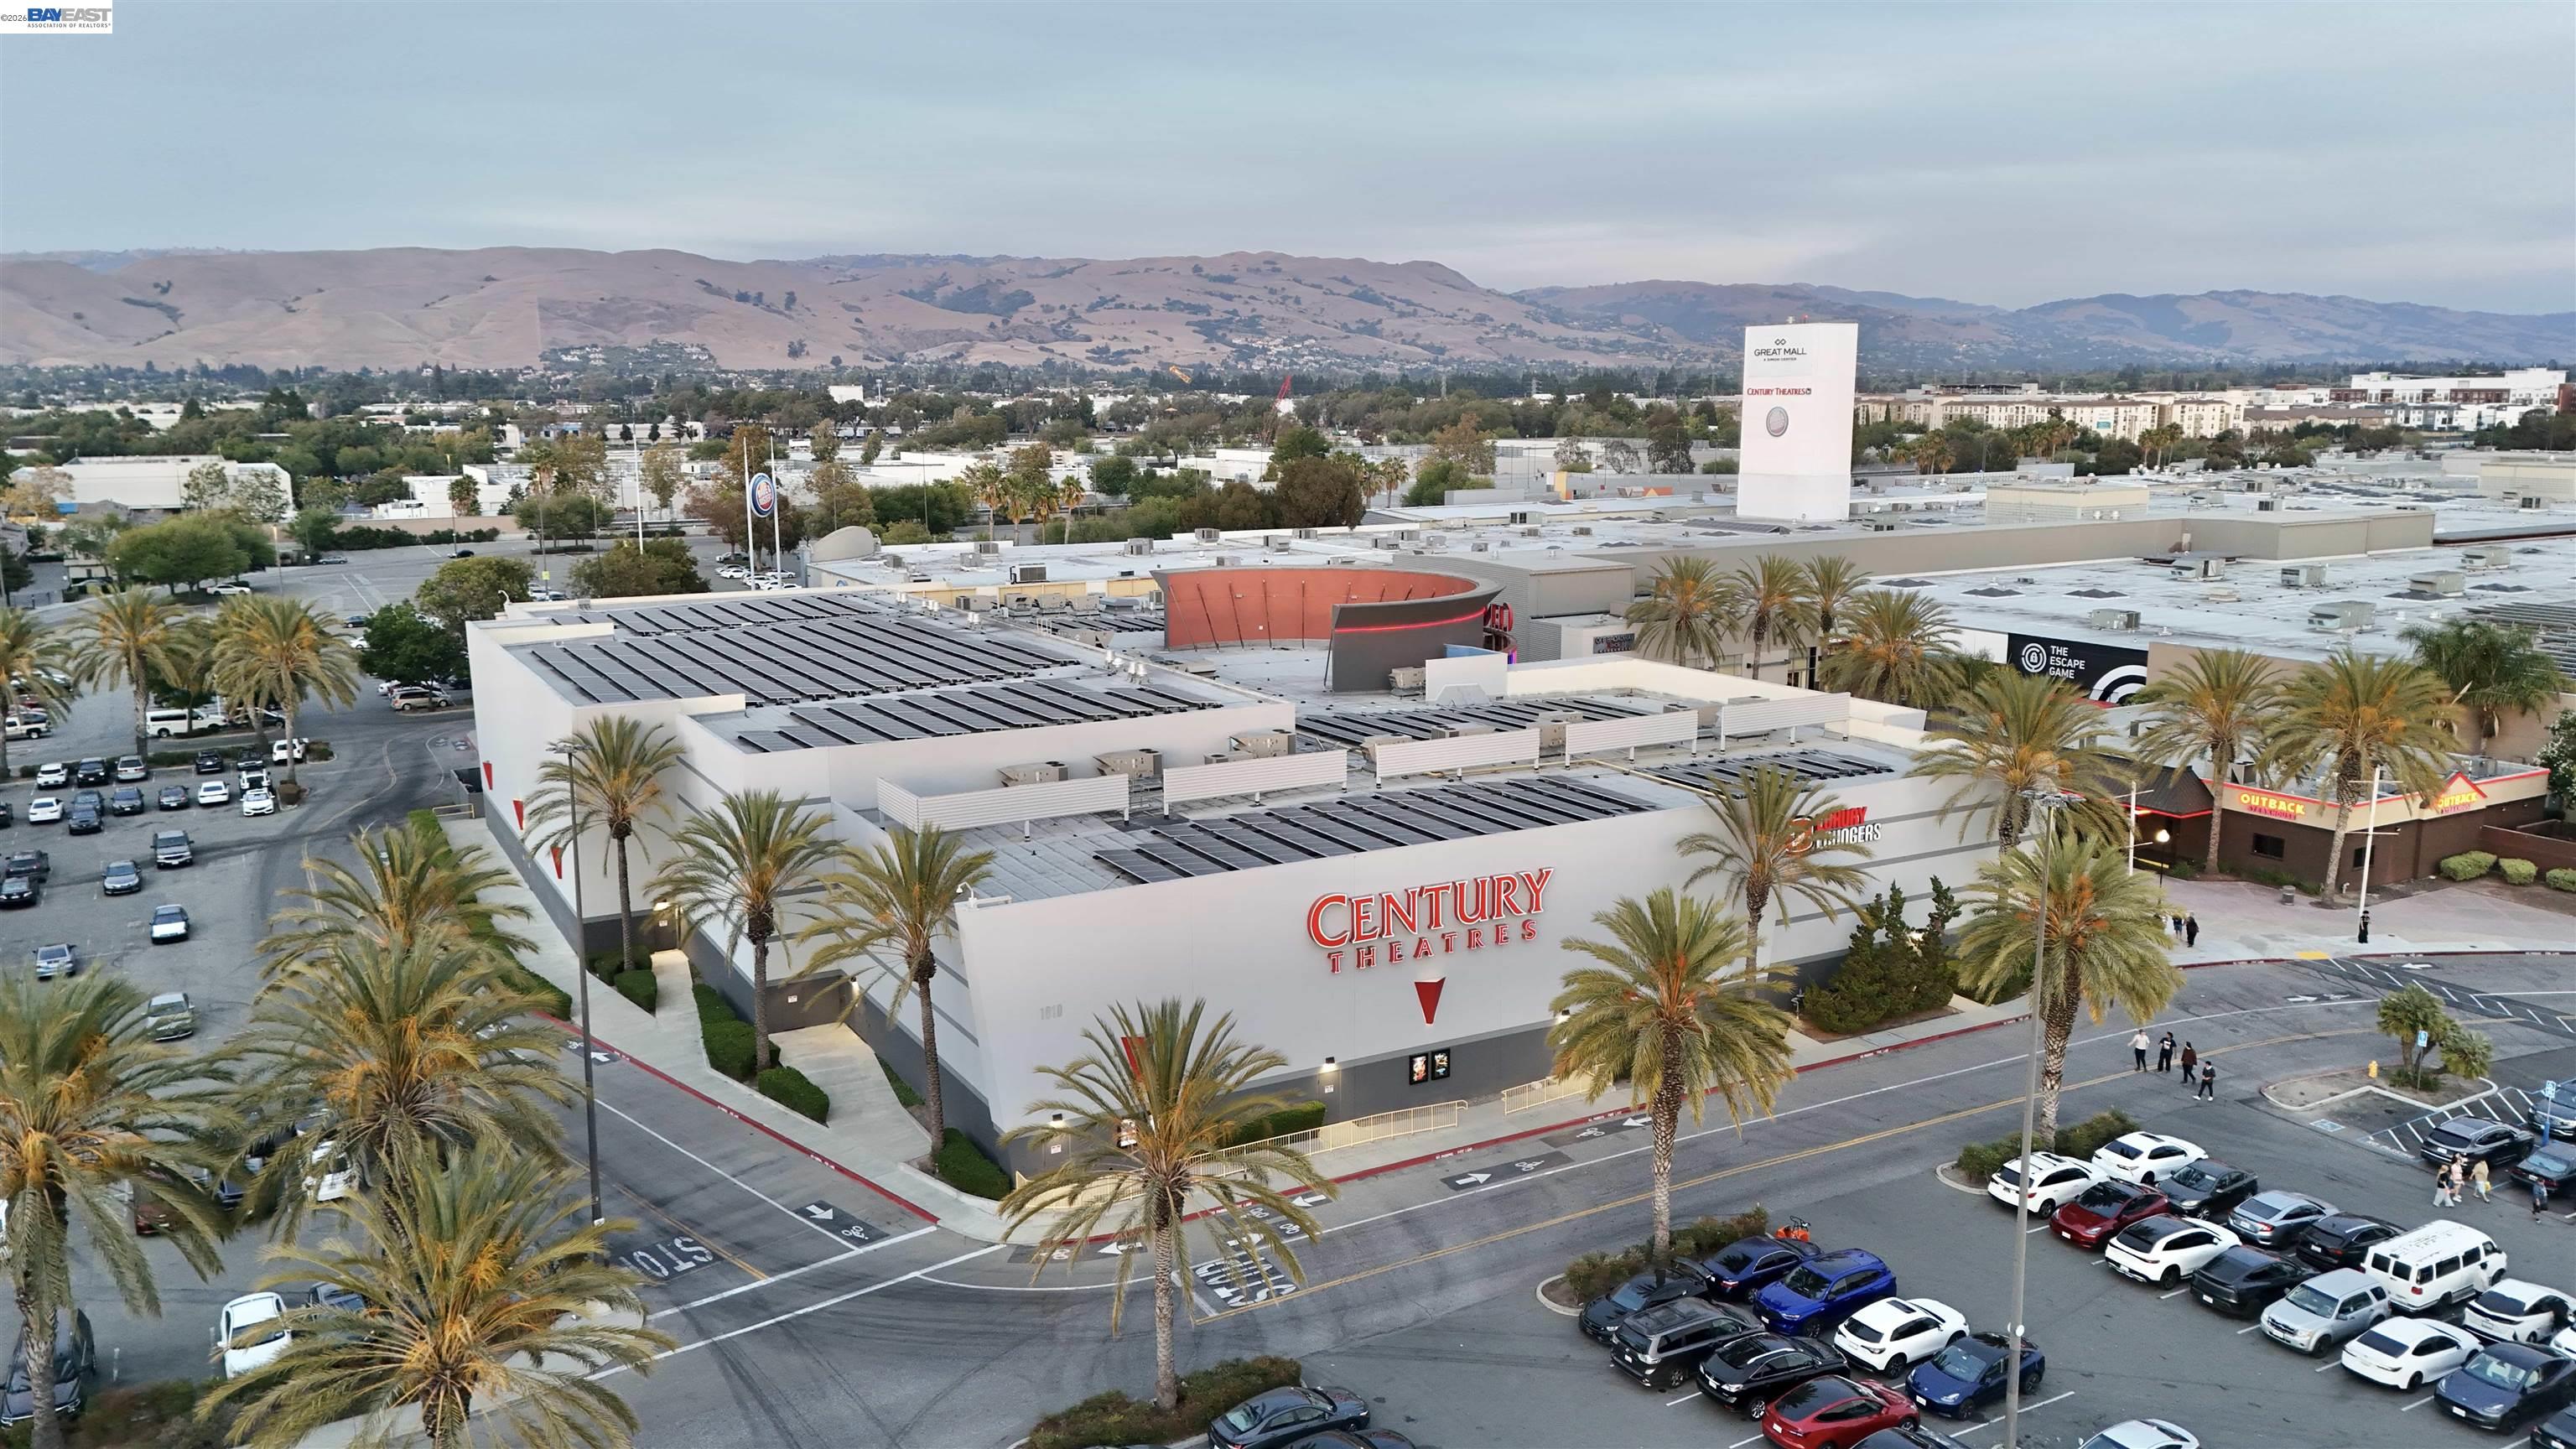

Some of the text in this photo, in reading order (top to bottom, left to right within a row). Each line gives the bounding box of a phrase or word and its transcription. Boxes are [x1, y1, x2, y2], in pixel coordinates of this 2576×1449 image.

[1754, 348, 1782, 356] GREAT
[1747, 387, 1805, 396] CENTURY THEATRES
[2050, 645, 2069, 657] THE
[2049, 657, 2085, 669] ESCAPE
[2049, 667, 2075, 678] GAME
[2241, 793, 2305, 814] OUTBACK
[2438, 792, 2478, 808] OUTBACK
[1306, 866, 1555, 949] CENTURY
[1327, 918, 1537, 974] THEATRES
[619, 1235, 714, 1278] STO
